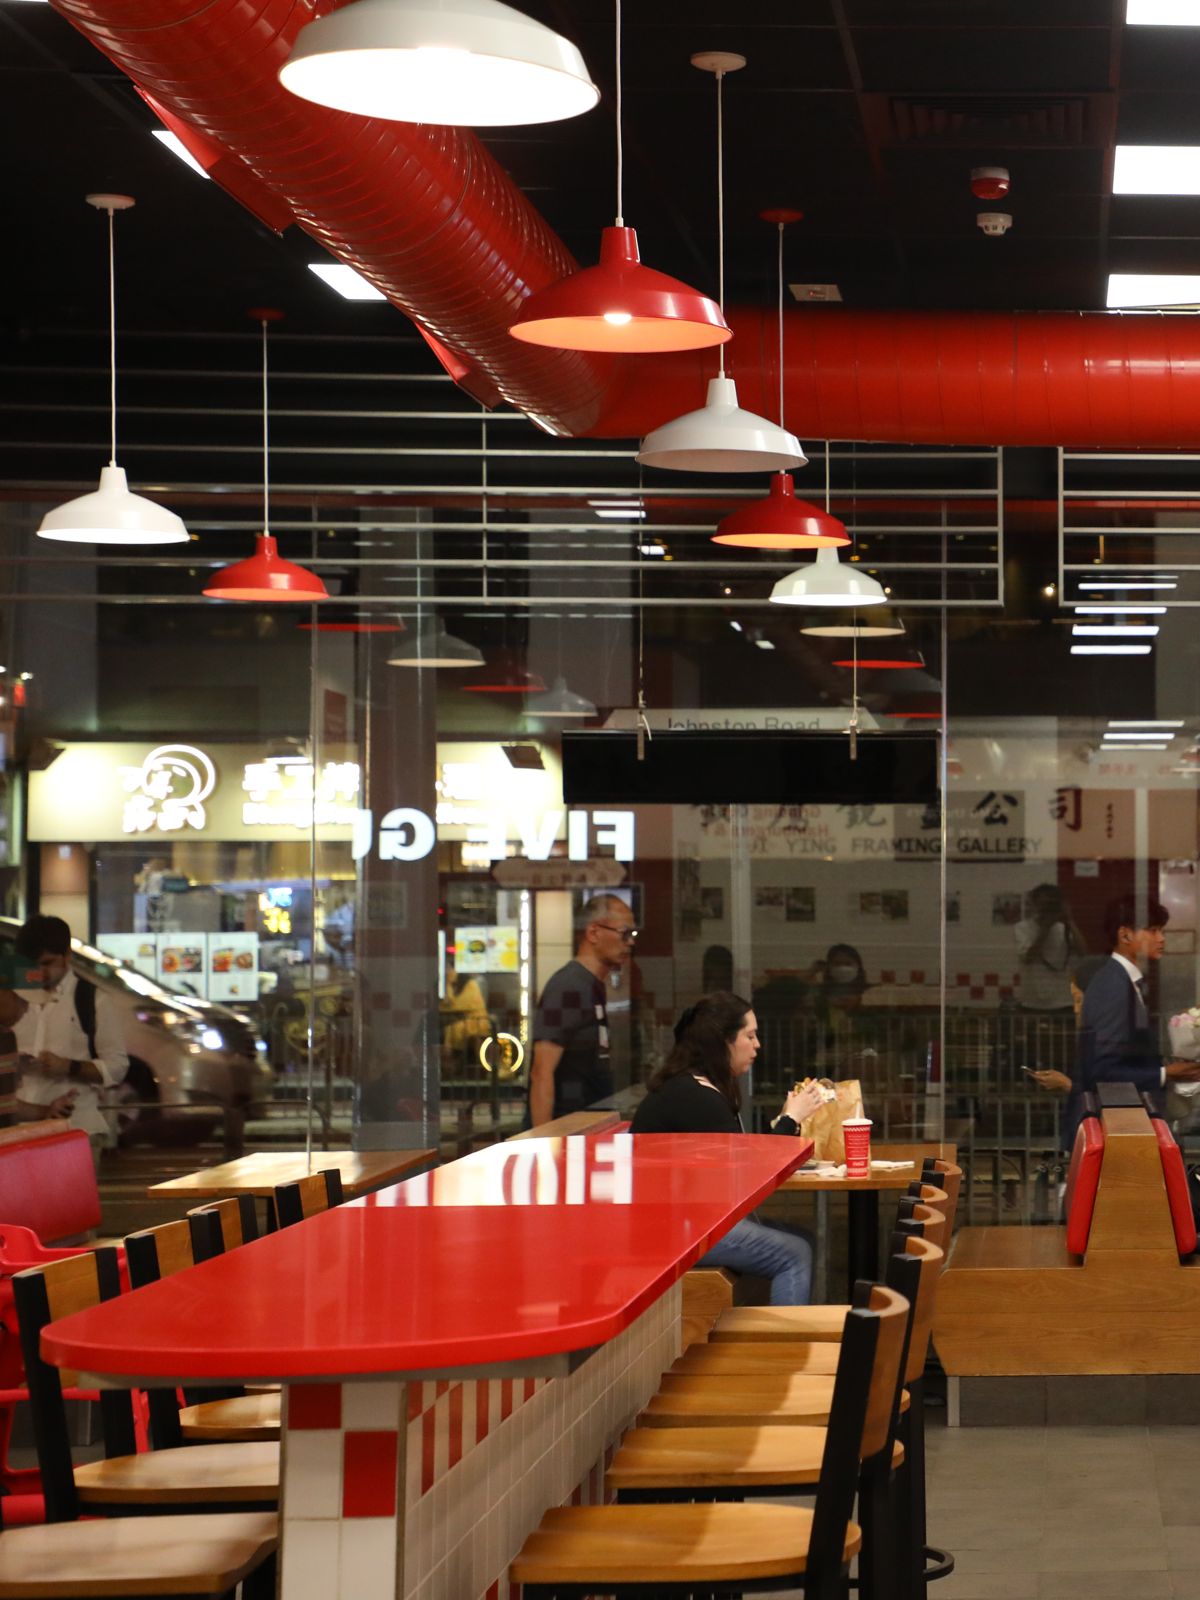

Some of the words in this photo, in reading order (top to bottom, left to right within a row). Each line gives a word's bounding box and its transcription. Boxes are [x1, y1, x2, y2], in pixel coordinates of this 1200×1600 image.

[668, 717, 757, 730] Johnston
[764, 717, 820, 730] Road
[786, 838, 837, 854] YING
[852, 838, 941, 855] FRAMING
[957, 838, 1042, 855] GALLERY
